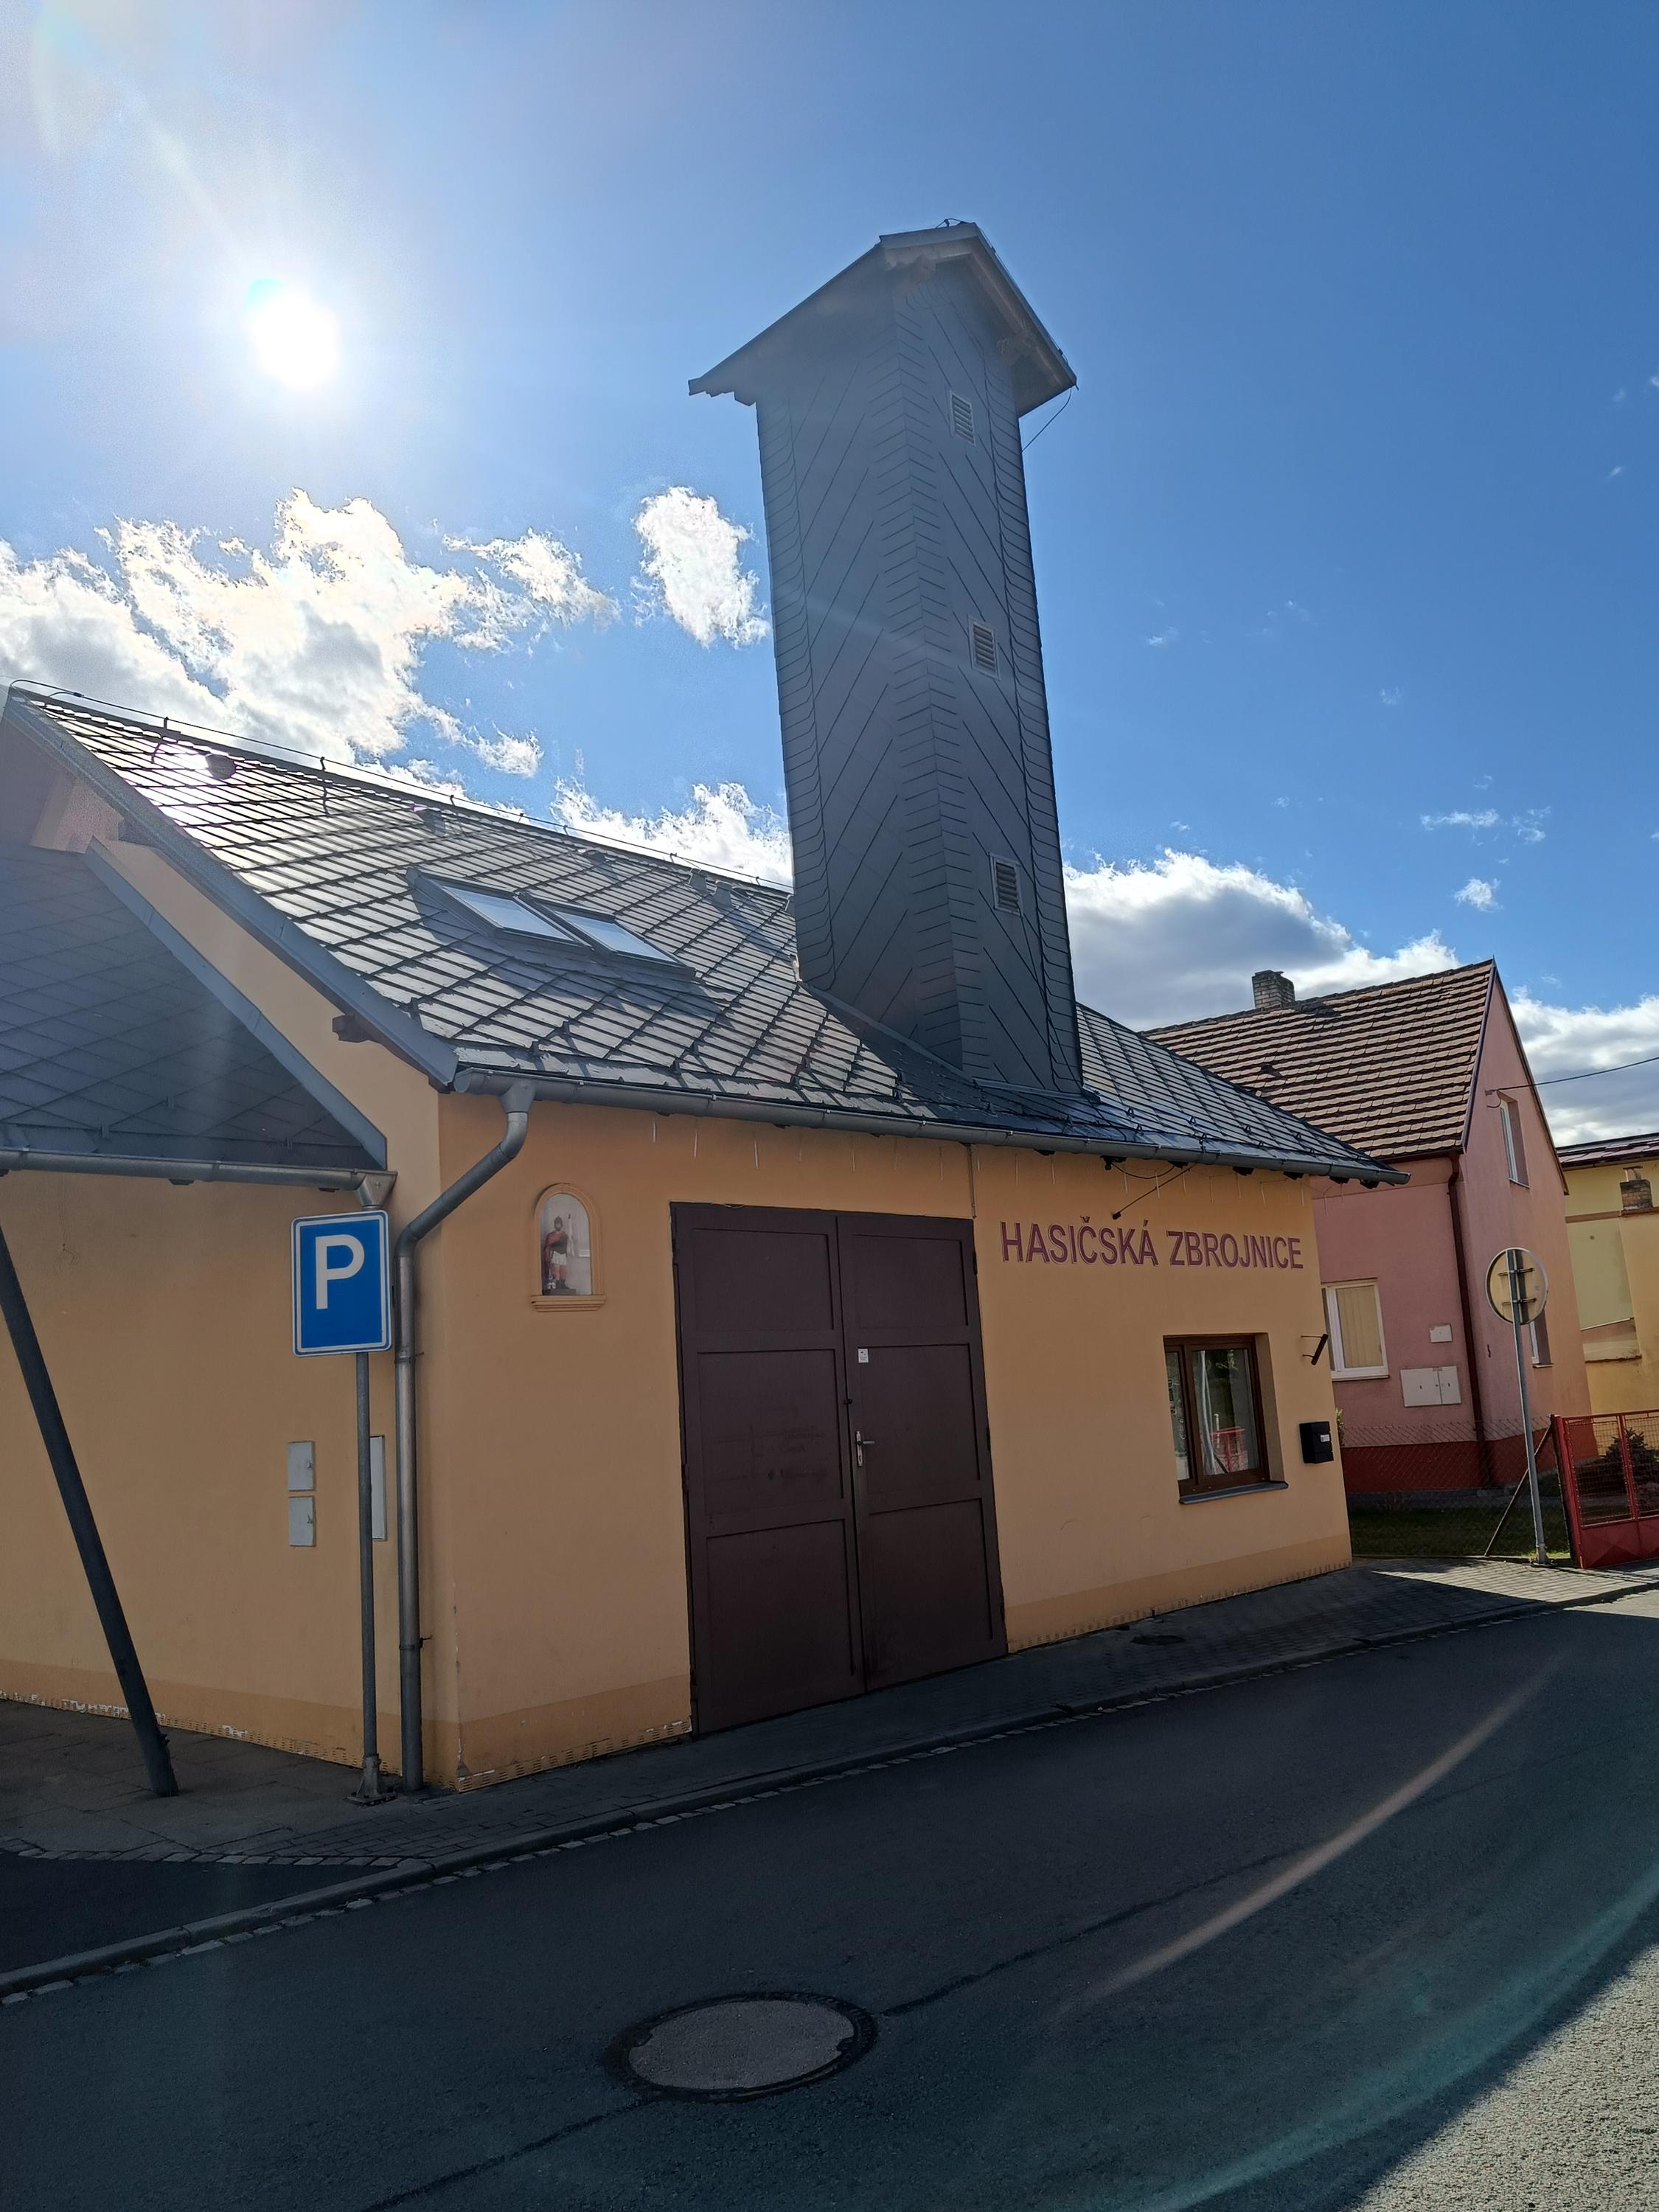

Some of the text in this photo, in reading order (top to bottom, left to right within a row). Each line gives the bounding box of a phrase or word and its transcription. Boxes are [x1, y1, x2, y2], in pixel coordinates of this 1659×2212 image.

[315, 1234, 365, 1310] P
[1000, 1216, 1304, 1269] HASIČSKÁ ZBROJNICE
